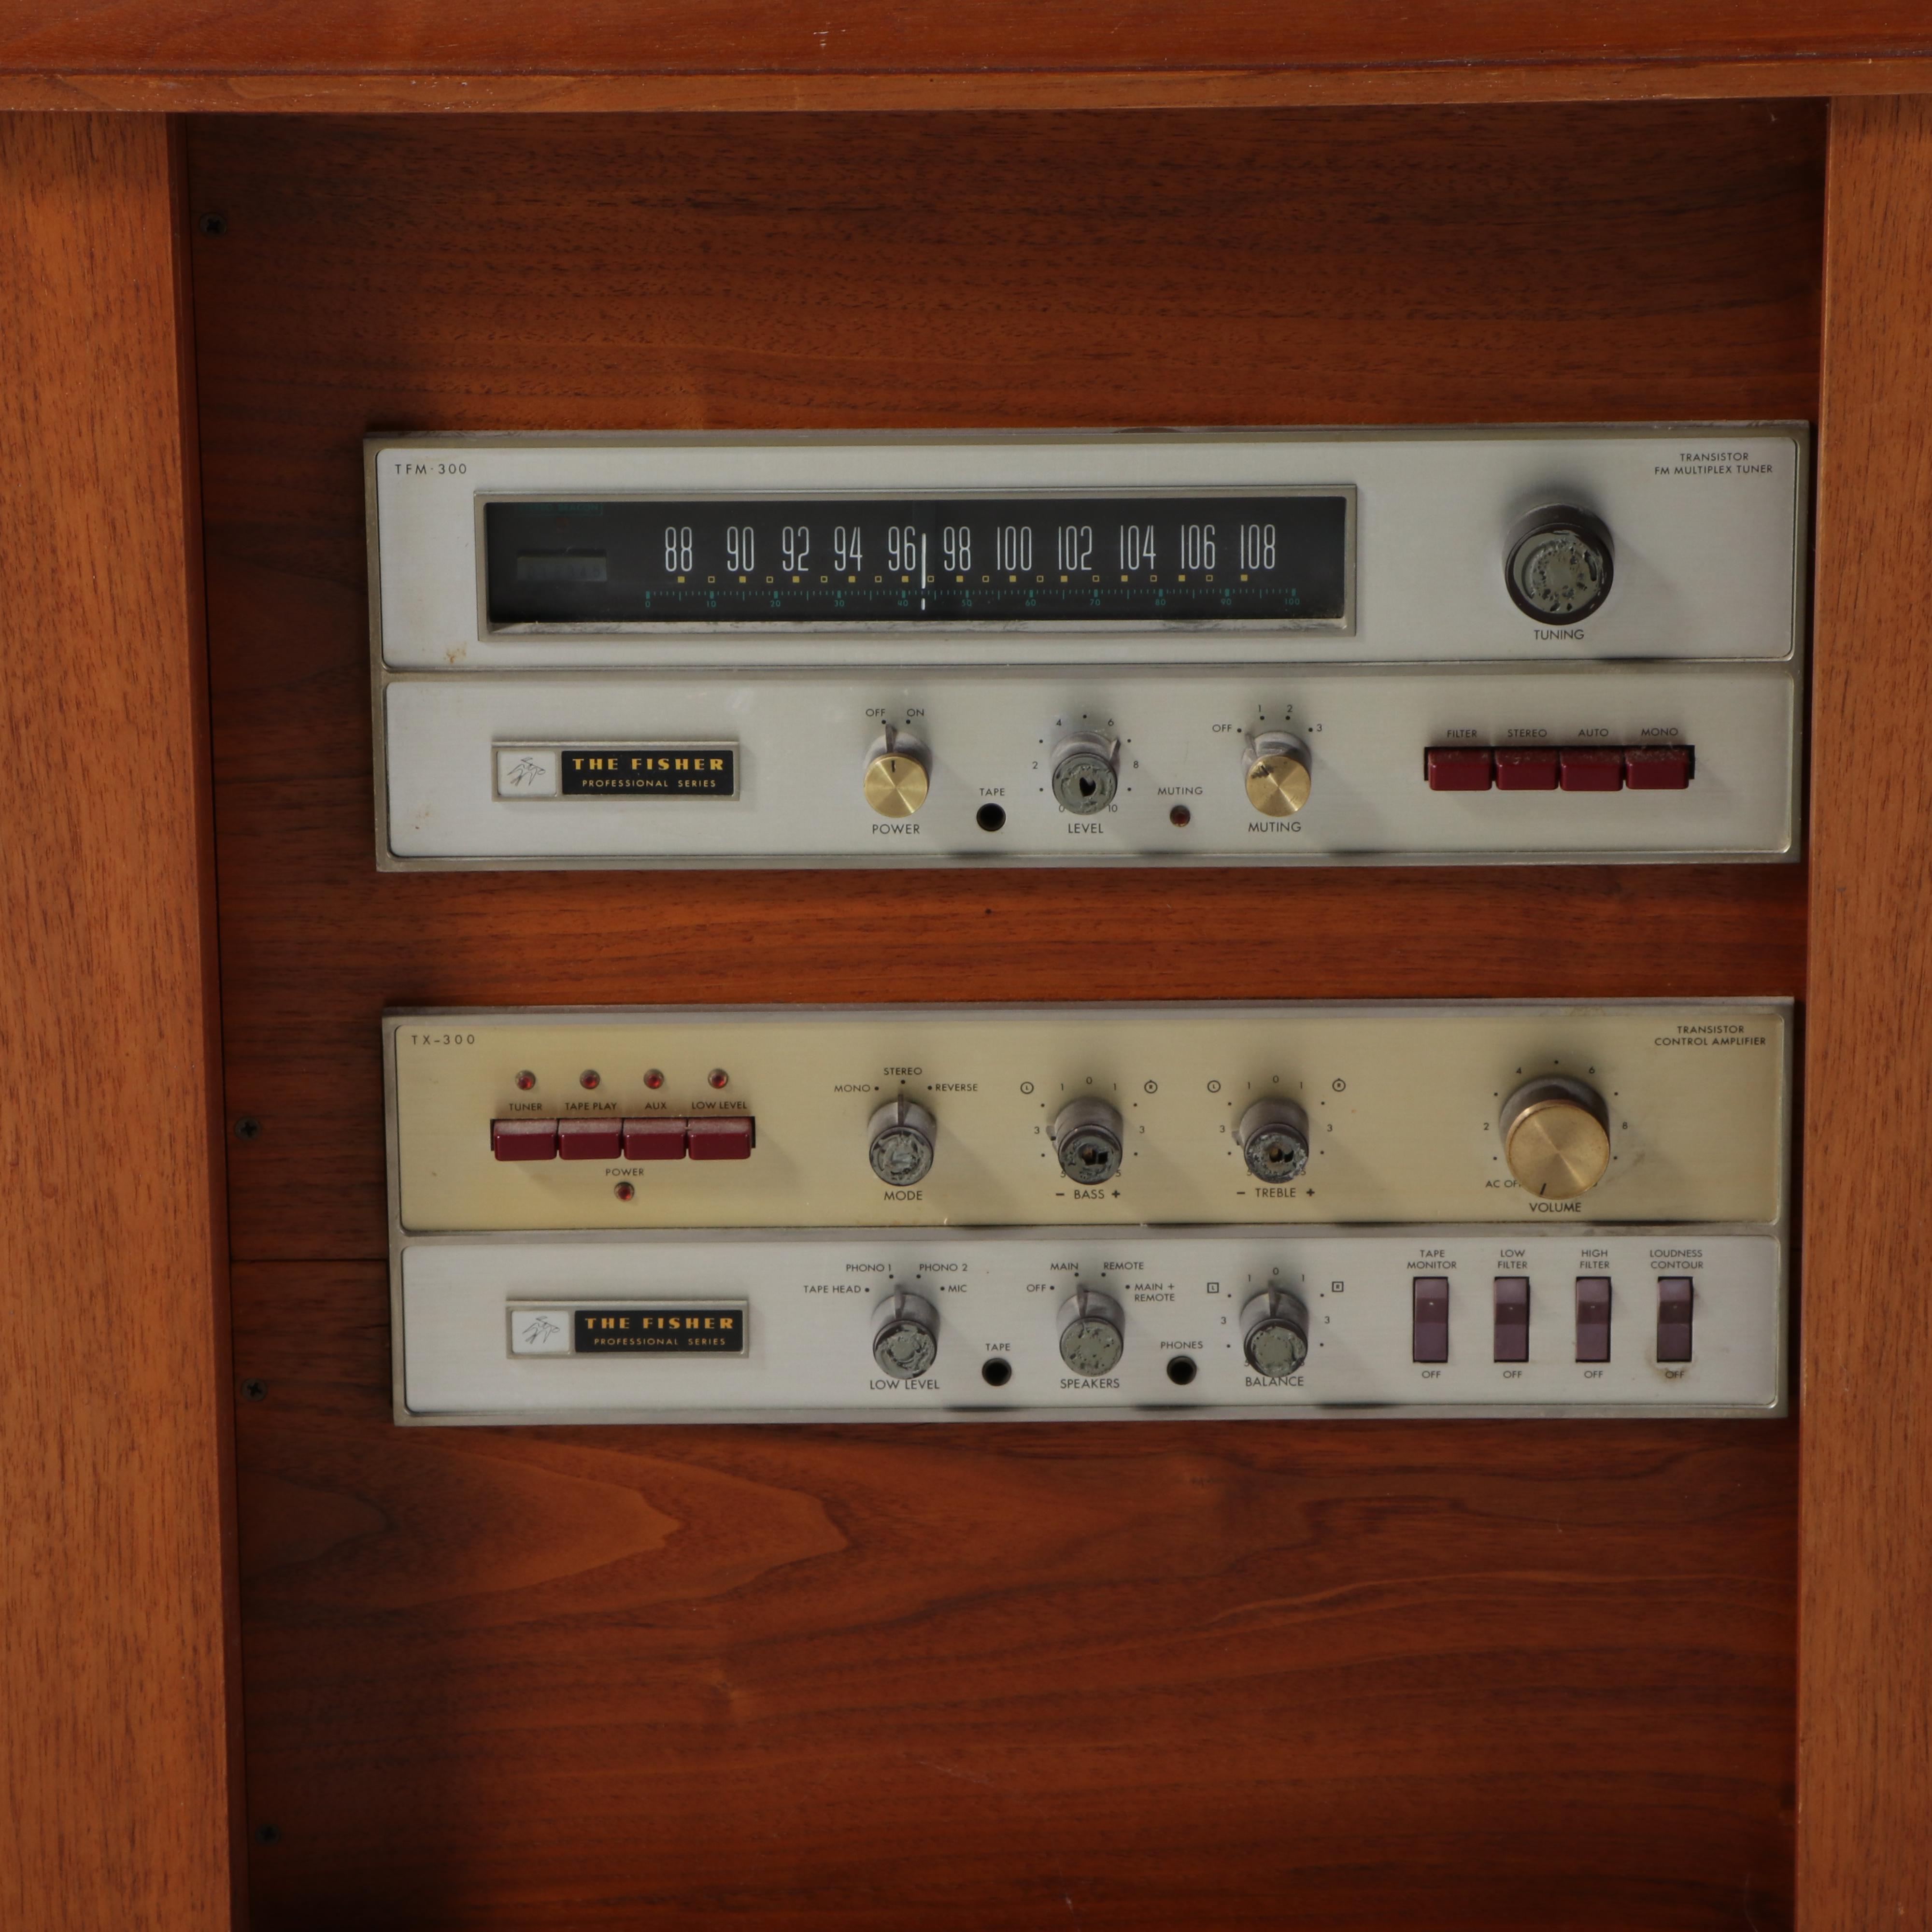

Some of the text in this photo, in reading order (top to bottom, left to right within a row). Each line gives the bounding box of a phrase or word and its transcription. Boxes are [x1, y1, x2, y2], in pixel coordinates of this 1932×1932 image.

[1679, 453, 1749, 461] TRANSISTOR
[395, 464, 468, 475] TFM-300
[1654, 465, 1773, 475] FM MULTIPLEX TUNER
[665, 524, 1276, 572] 88 90 92 94 96 98 100 102 104 106 108
[1534, 630, 1584, 639] TUNING
[1578, 728, 1609, 737] AUTO
[1642, 728, 1678, 736] MONO
[572, 759, 724, 770] THE FISHER
[980, 788, 1005, 796] TAPE
[872, 824, 920, 834] POWER
[1068, 823, 1103, 833] LEVEL
[1249, 822, 1301, 832] MUTING
[412, 1035, 475, 1045] TX-300
[1655, 1037, 1766, 1046] CONTROL AMPLIFIER
[1273, 1075, 1279, 1083] 0
[884, 1191, 923, 1200] MODE
[1074, 1190, 1104, 1199] BASS
[1256, 1188, 1296, 1197] TREBLE
[1529, 1203, 1581, 1212] VOLUME
[585, 1318, 733, 1329] THE FISHER
[870, 1379, 939, 1390] LOW LEVEL
[1060, 1379, 1120, 1389] SPEAKERS
[1246, 1377, 1304, 1386] BALANCE
